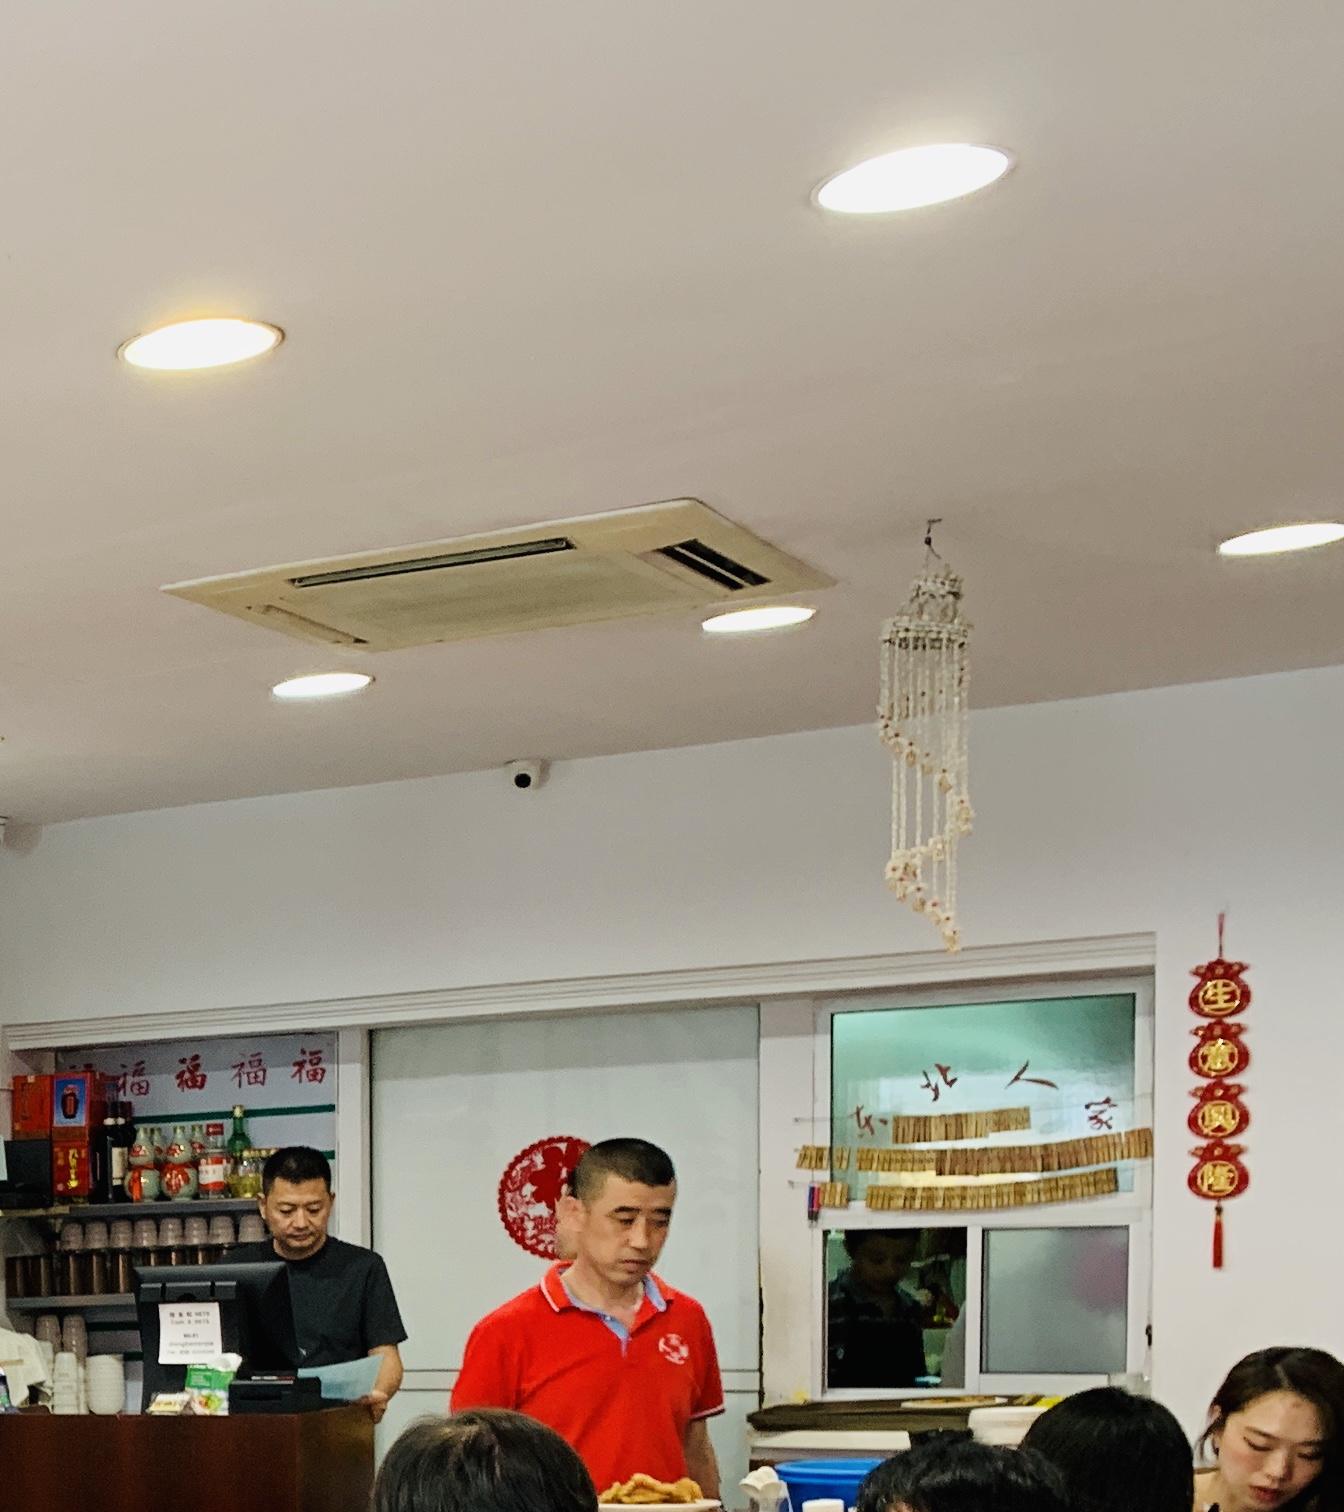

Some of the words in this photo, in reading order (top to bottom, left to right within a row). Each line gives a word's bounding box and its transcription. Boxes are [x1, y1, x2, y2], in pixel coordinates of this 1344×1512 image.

[175, 1054, 207, 1091] 福
[231, 1052, 268, 1089] 福
[291, 1047, 326, 1085] 福
